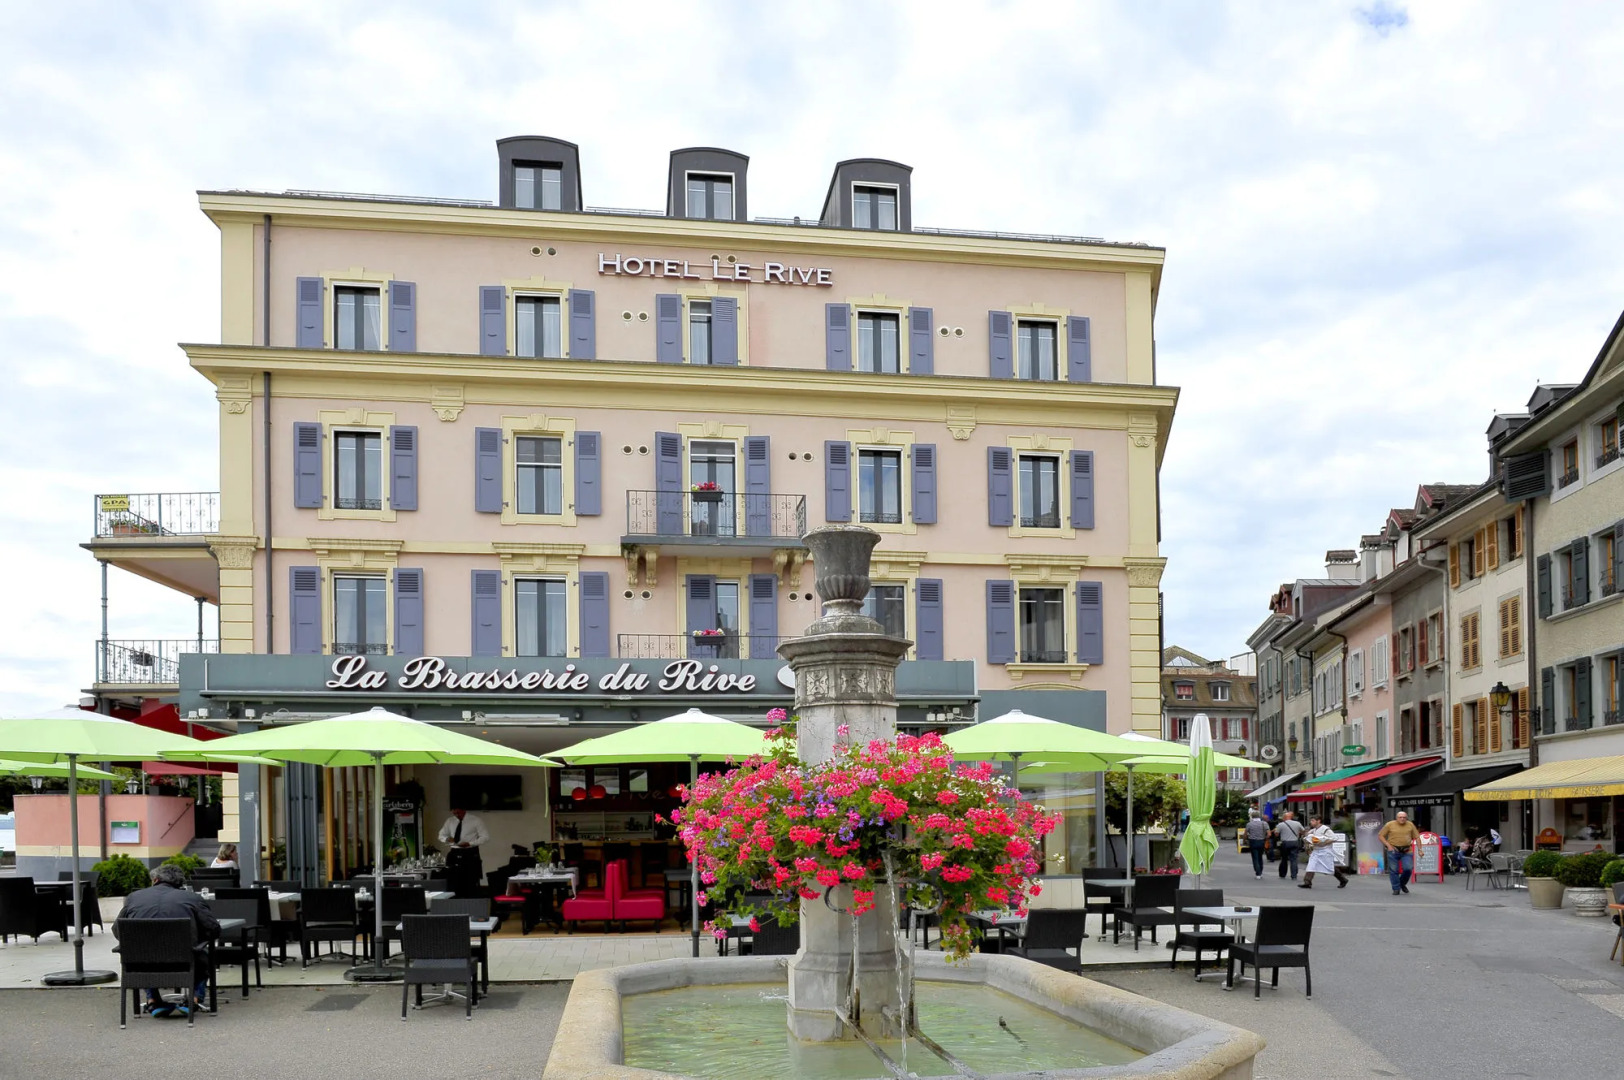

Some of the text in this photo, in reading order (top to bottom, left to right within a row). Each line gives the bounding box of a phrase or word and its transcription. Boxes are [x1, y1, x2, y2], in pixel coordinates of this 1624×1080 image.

[598, 252, 833, 286] HOTEL LE RIVE
[326, 655, 756, 691] La Brasserie du Rive
